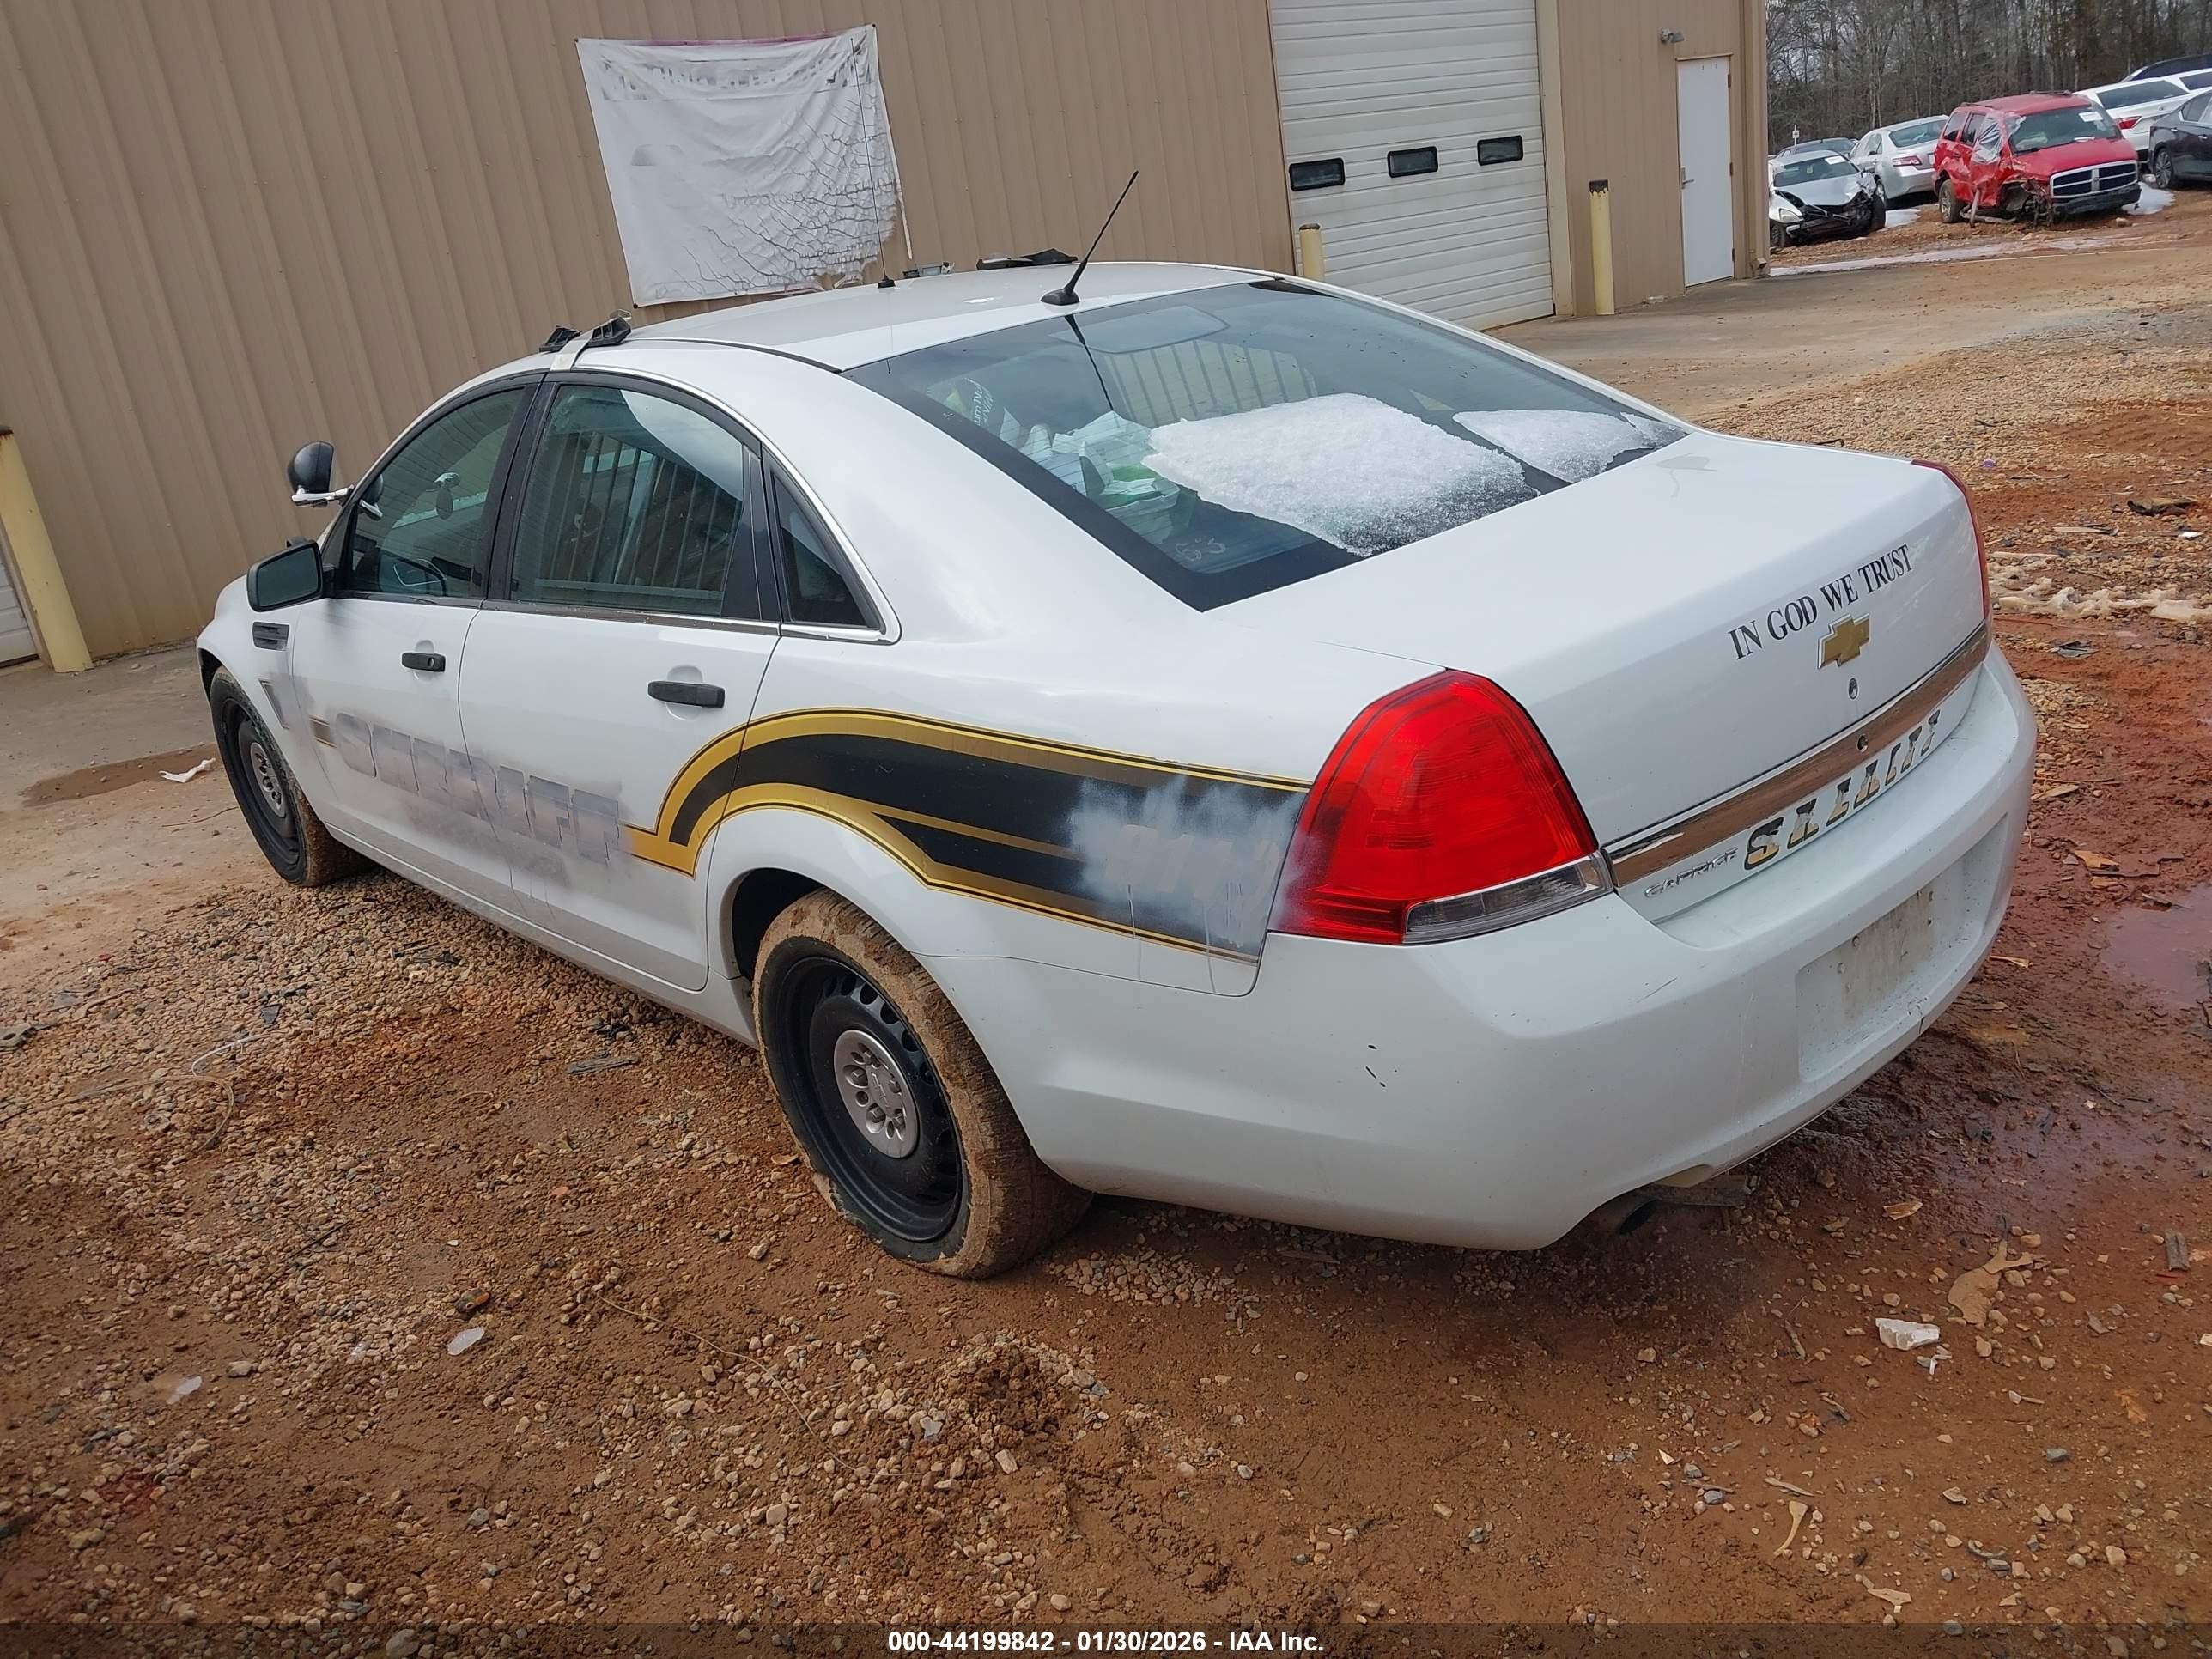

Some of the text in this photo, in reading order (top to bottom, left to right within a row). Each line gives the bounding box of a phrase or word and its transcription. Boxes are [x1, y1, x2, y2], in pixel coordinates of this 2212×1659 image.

[1728, 544, 1913, 659] IN GOD WE TRUST
